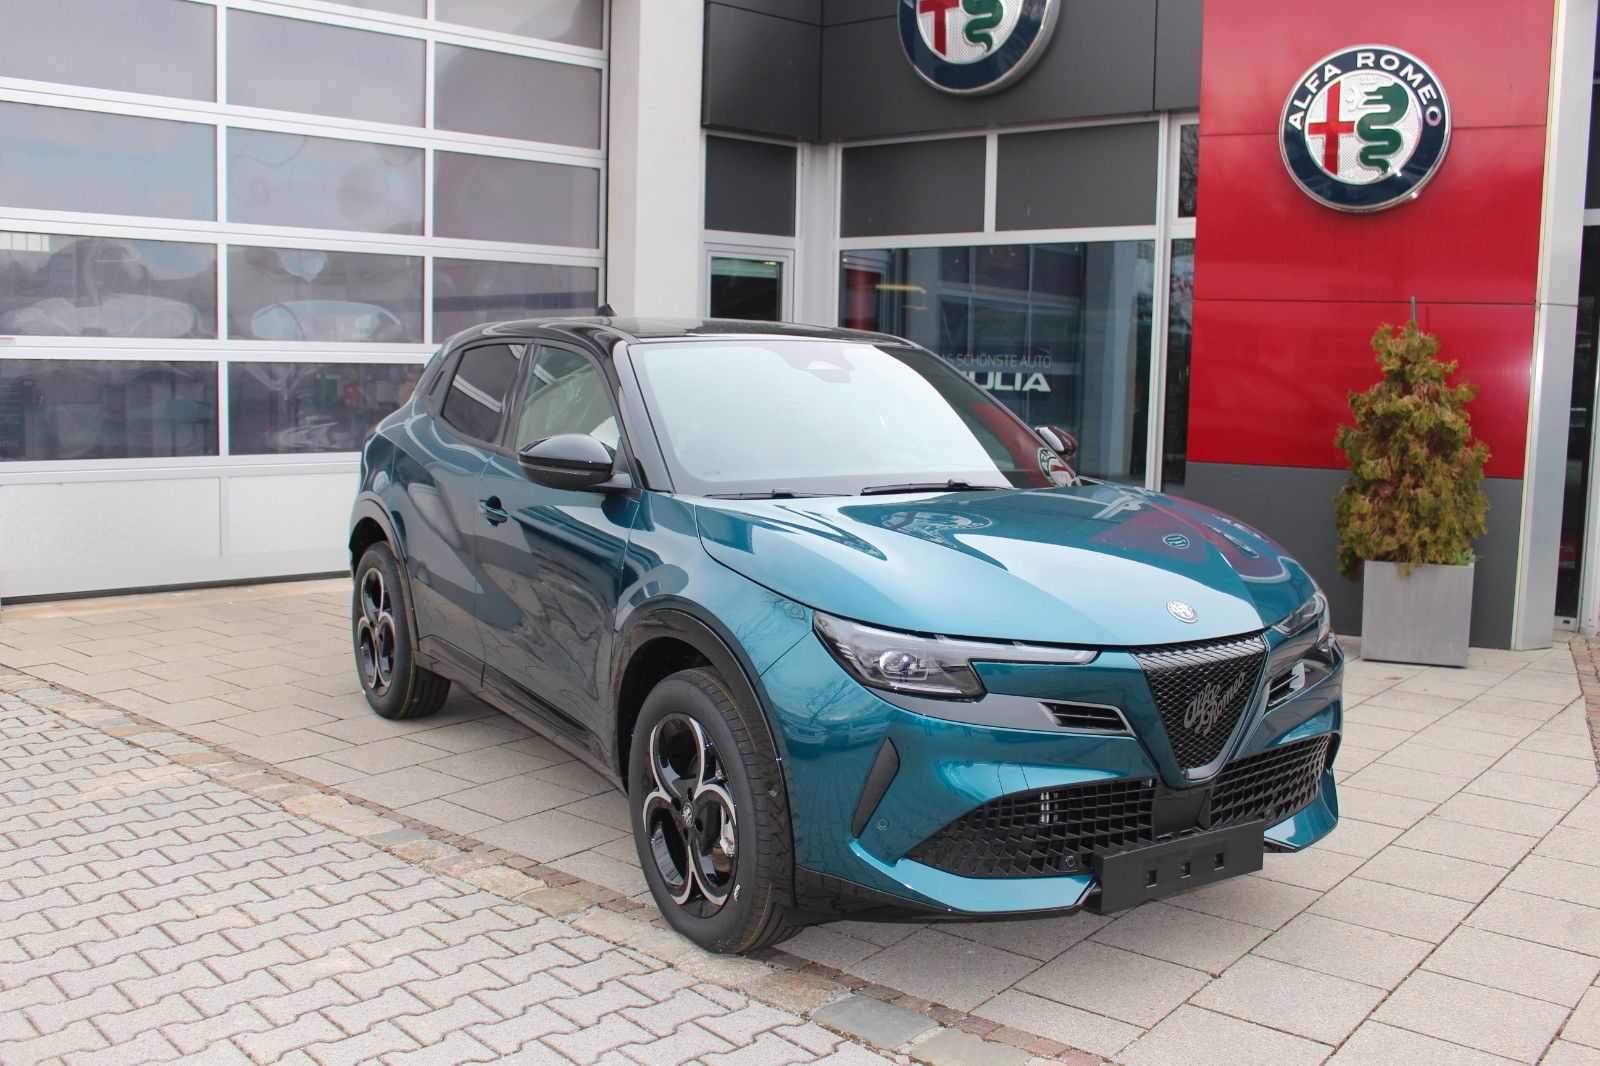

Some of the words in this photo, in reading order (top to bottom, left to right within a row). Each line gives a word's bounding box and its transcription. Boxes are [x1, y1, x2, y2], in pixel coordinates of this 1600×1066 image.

[1288, 63, 1342, 130] ALFA
[1356, 51, 1442, 126] ROMEO
[957, 351, 1018, 368] SCHÖNSTE
[1020, 354, 1052, 369] AUTO
[965, 371, 1051, 392] ULIA
